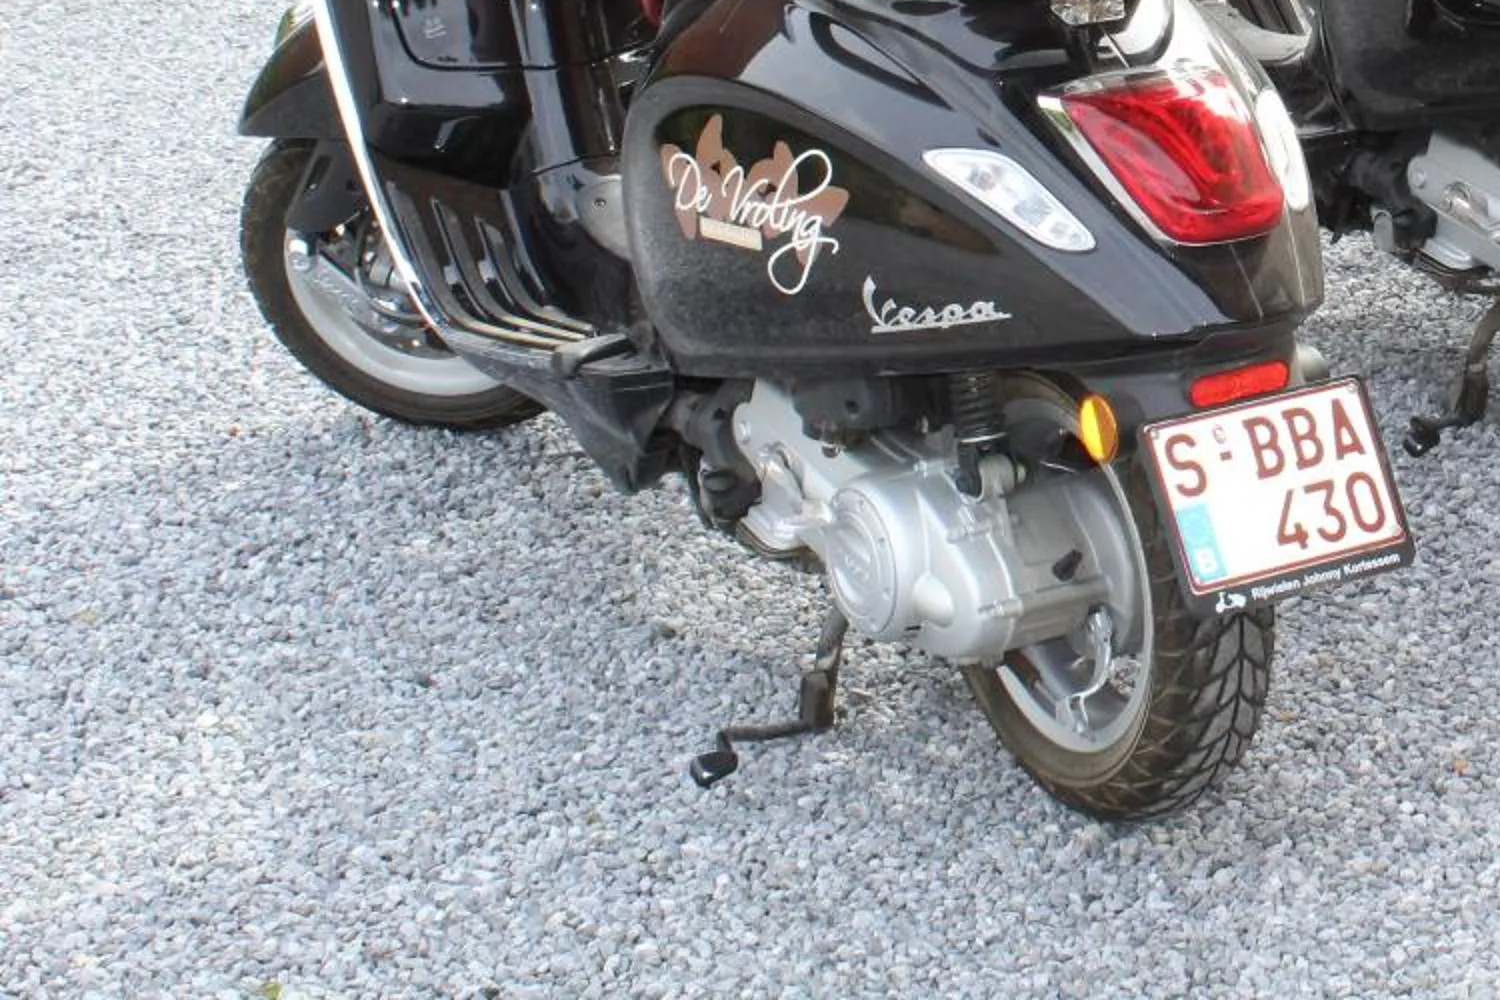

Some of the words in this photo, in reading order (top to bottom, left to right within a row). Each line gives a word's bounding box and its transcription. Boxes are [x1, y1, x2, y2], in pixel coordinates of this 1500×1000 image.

[668, 152, 713, 213] De
[720, 148, 839, 296] Vroling
[862, 275, 1013, 334] Vespa
[1275, 470, 1387, 550] 430
